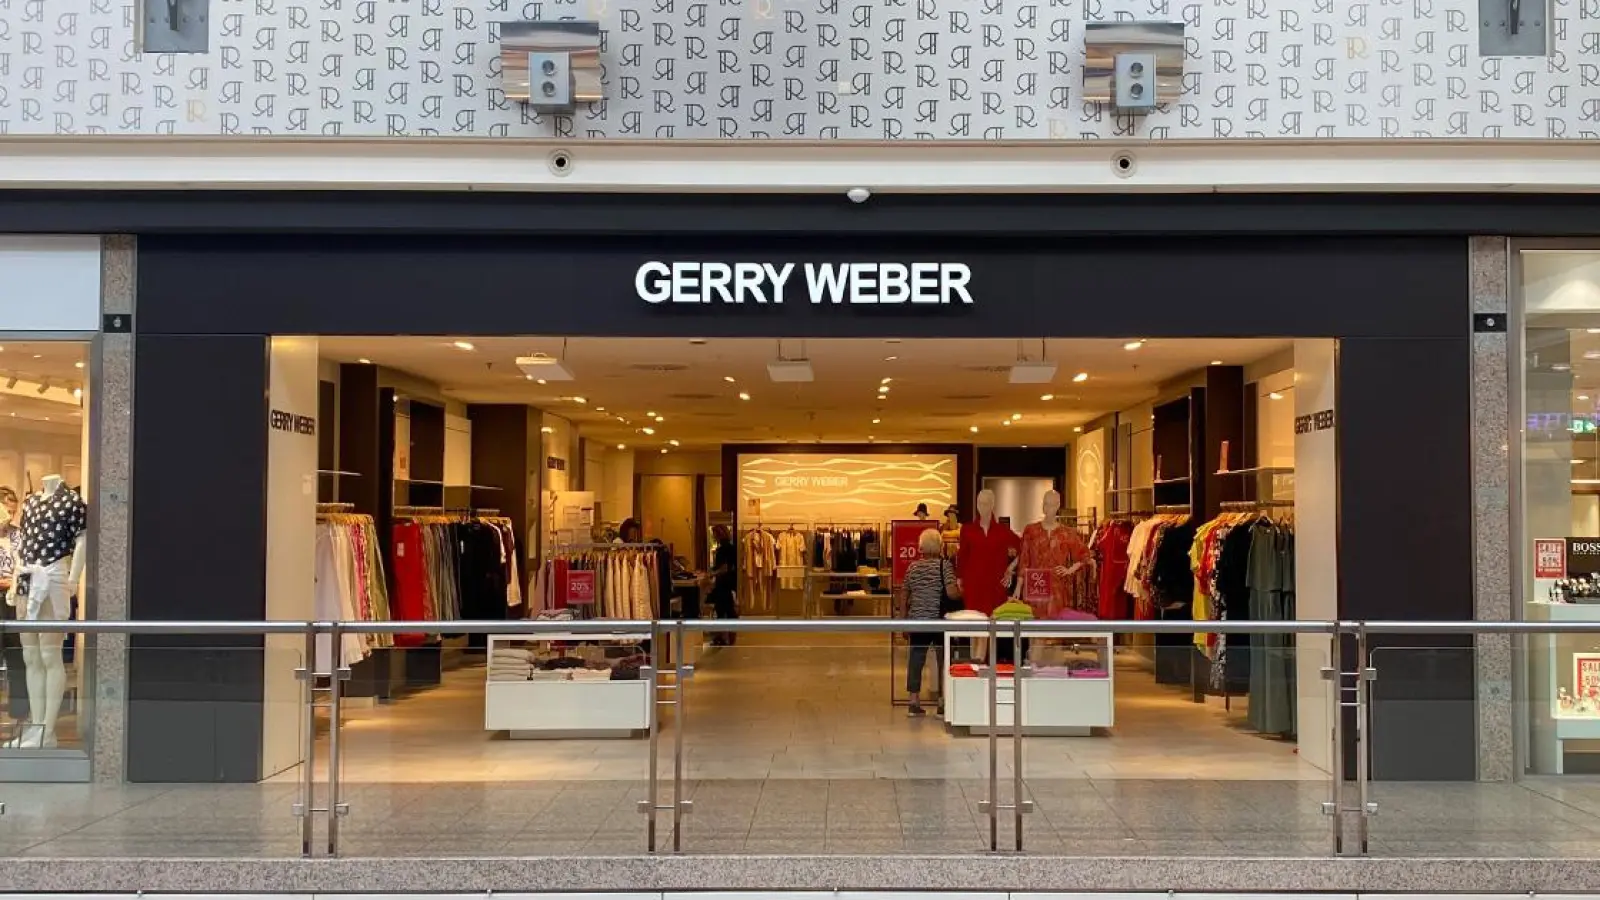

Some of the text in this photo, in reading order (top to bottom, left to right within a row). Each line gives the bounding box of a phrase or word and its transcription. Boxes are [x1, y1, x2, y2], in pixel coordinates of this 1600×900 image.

[635, 261, 974, 303] GERRY WEBER
[271, 409, 315, 436] GERRY WEBER
[775, 476, 848, 487] GERRY WEBER
